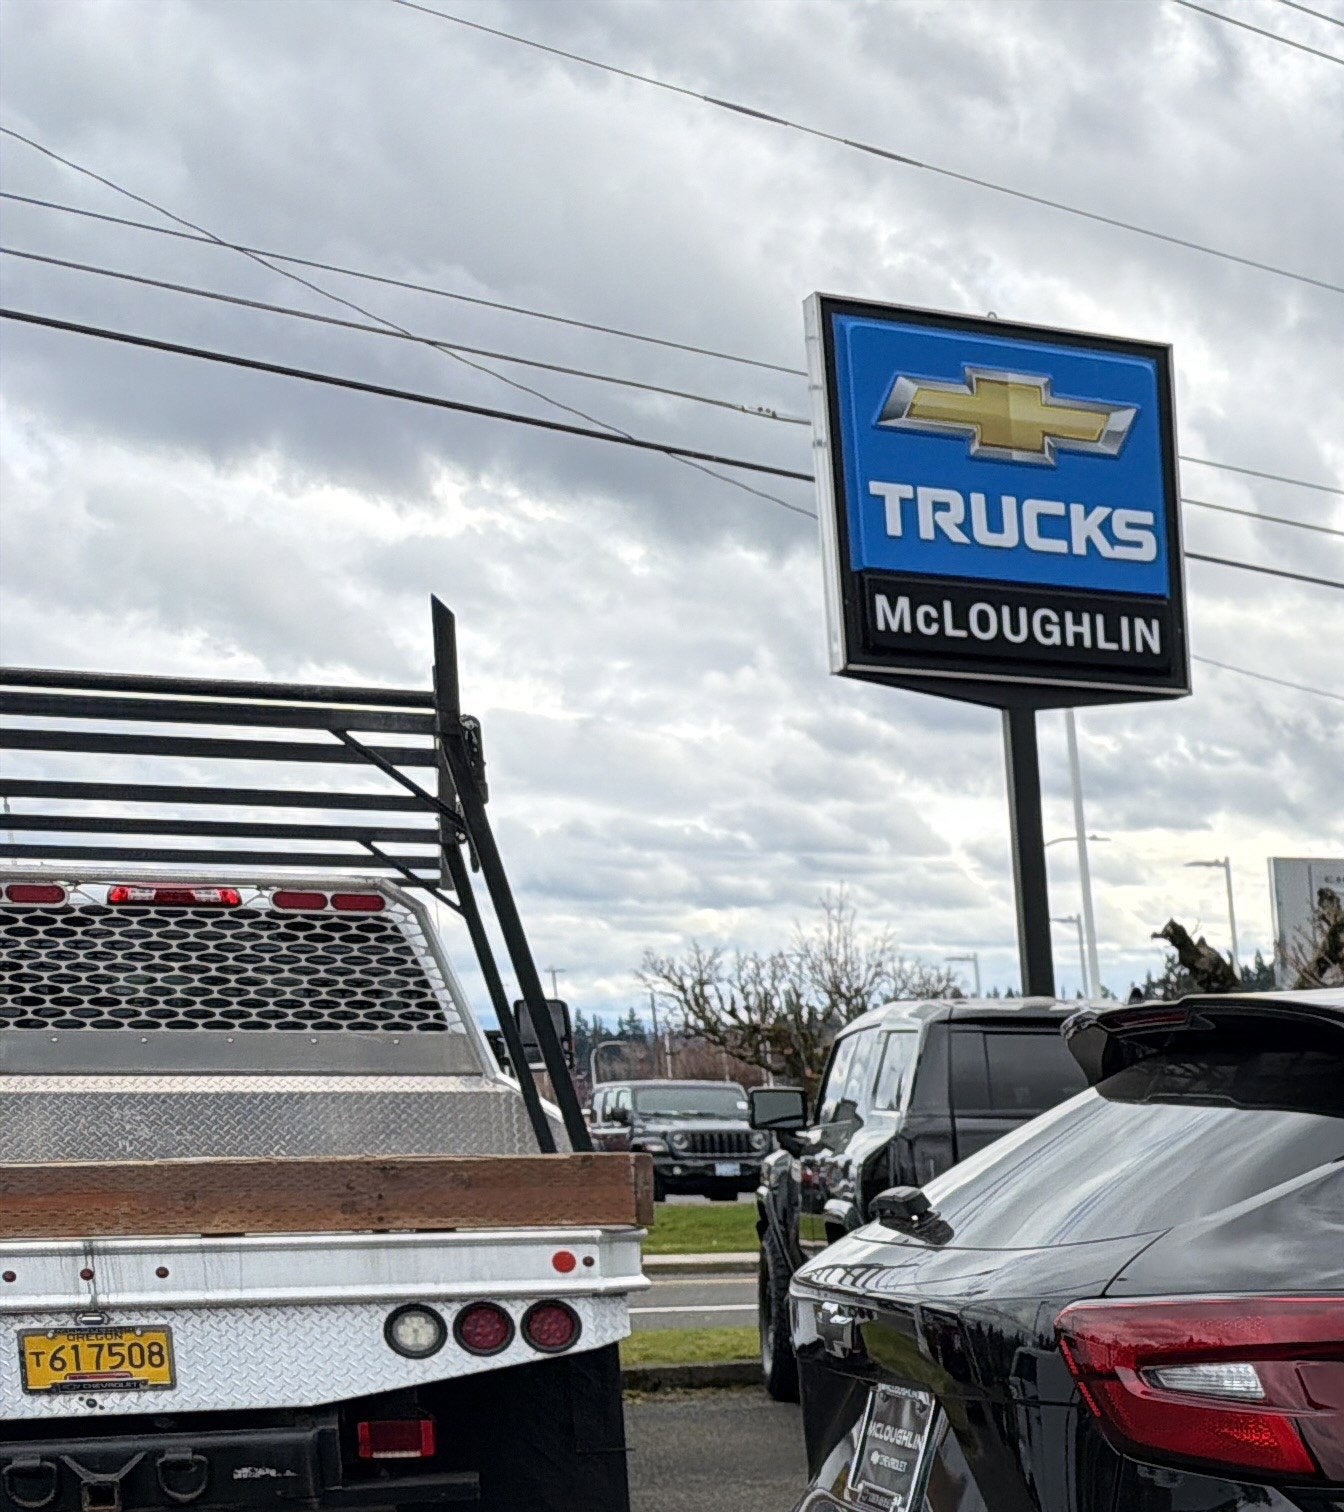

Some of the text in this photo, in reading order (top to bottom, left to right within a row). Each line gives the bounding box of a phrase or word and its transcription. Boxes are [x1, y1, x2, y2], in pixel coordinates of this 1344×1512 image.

[868, 480, 1158, 563] TRUCKS
[874, 593, 1162, 655] McLOUGHLIN
[29, 1341, 165, 1372] T617508
[66, 1333, 124, 1342] OREGON
